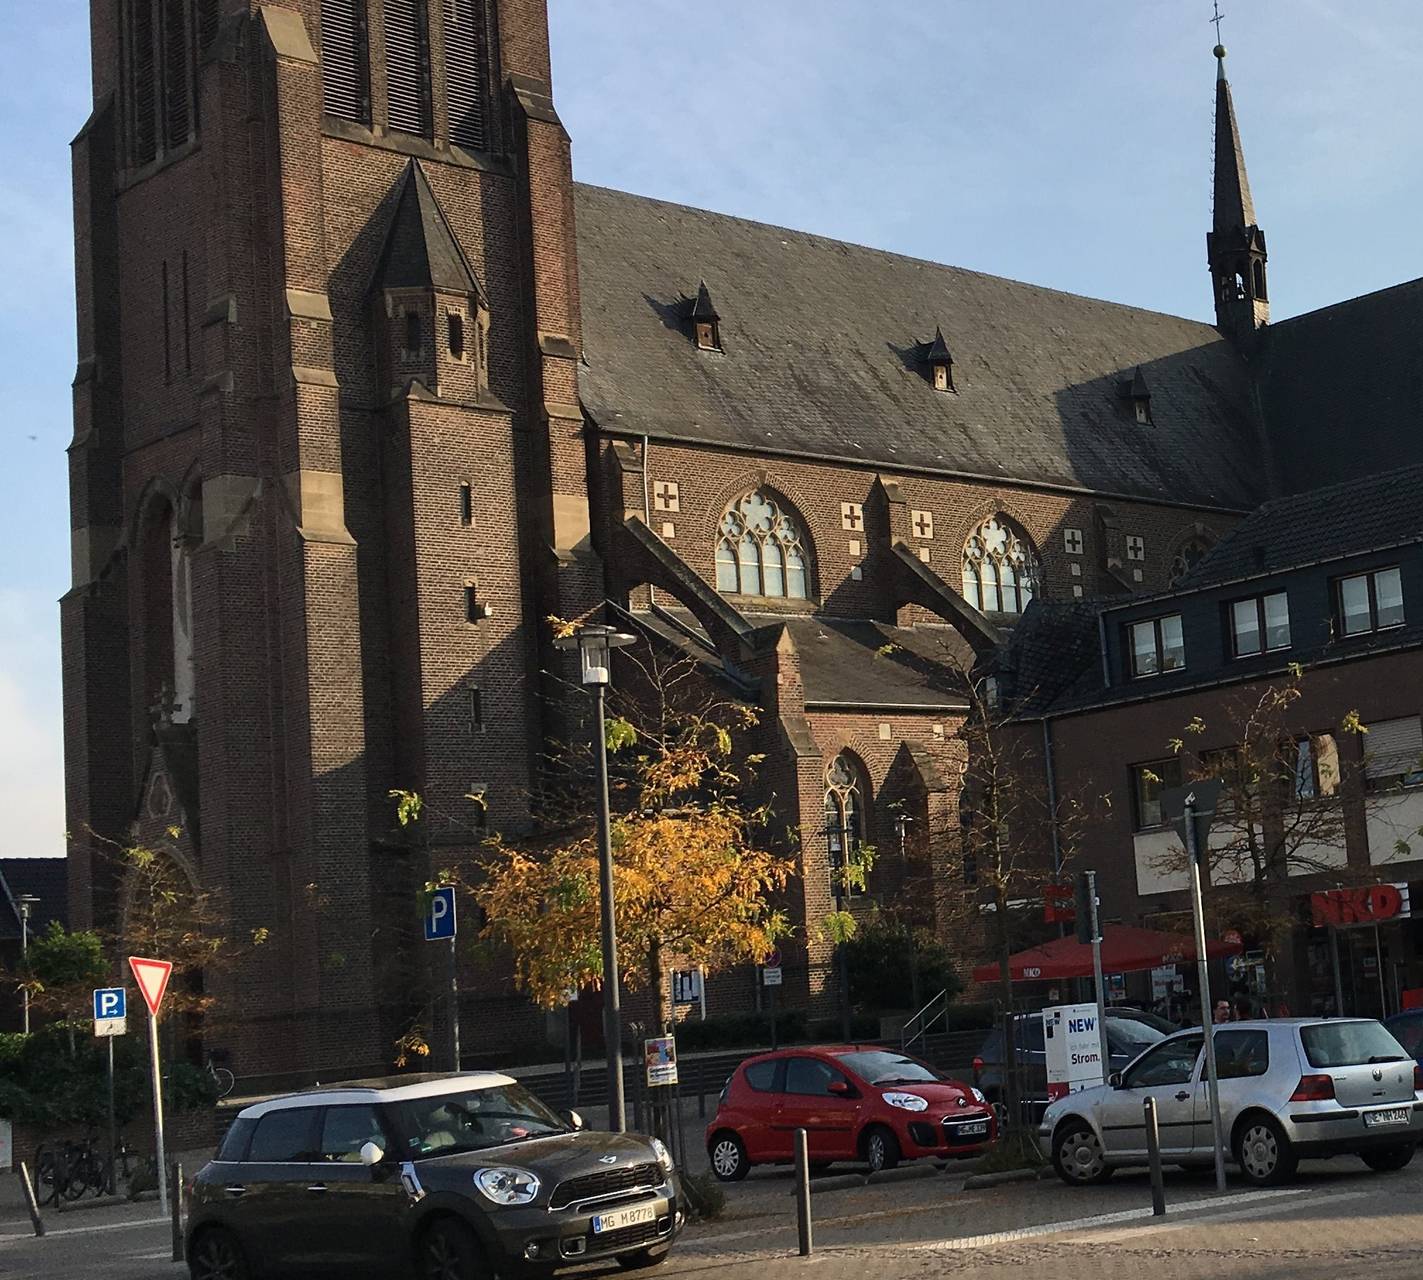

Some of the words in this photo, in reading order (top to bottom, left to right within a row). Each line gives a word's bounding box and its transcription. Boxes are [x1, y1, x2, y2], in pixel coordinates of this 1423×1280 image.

[432, 896, 447, 932] P
[1311, 884, 1401, 928] NKD
[1023, 967, 1041, 977] NKD
[102, 993, 118, 1016] P
[1068, 1017, 1095, 1033] NEW
[1071, 1053, 1101, 1064] Strom.
[602, 1215, 615, 1229] MG
